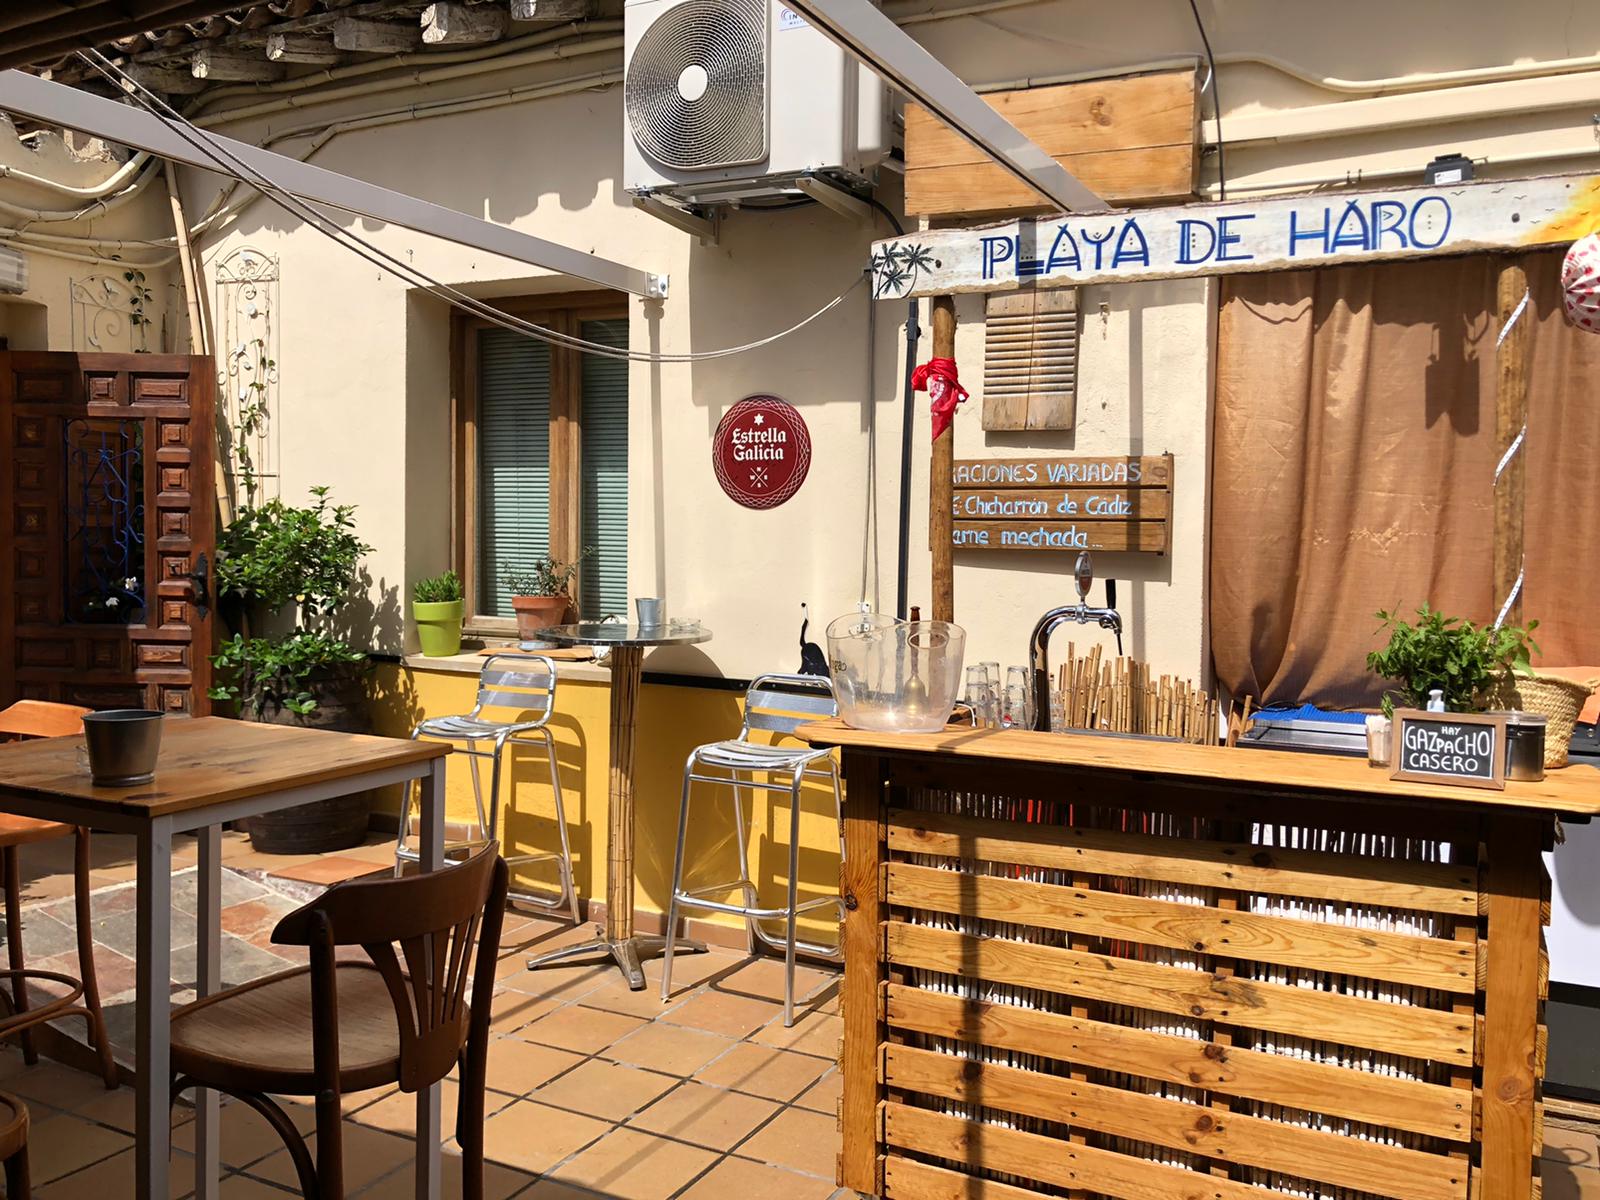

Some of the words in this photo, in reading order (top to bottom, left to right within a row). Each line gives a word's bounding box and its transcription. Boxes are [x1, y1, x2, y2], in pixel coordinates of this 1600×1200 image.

[980, 217, 1149, 279] PLAYA
[1174, 214, 1256, 264] DE
[1289, 195, 1452, 256] HARO
[731, 427, 787, 444] Estrella
[733, 443, 784, 461] Galicia
[953, 463, 1038, 483] ACIONES
[1046, 462, 1142, 483] VARIADAS
[1056, 494, 1077, 514] de
[952, 529, 989, 545] arne
[1405, 726, 1491, 756] GAZPACHO
[1441, 726, 1461, 736] HAY
[1409, 752, 1479, 772] CASERO
